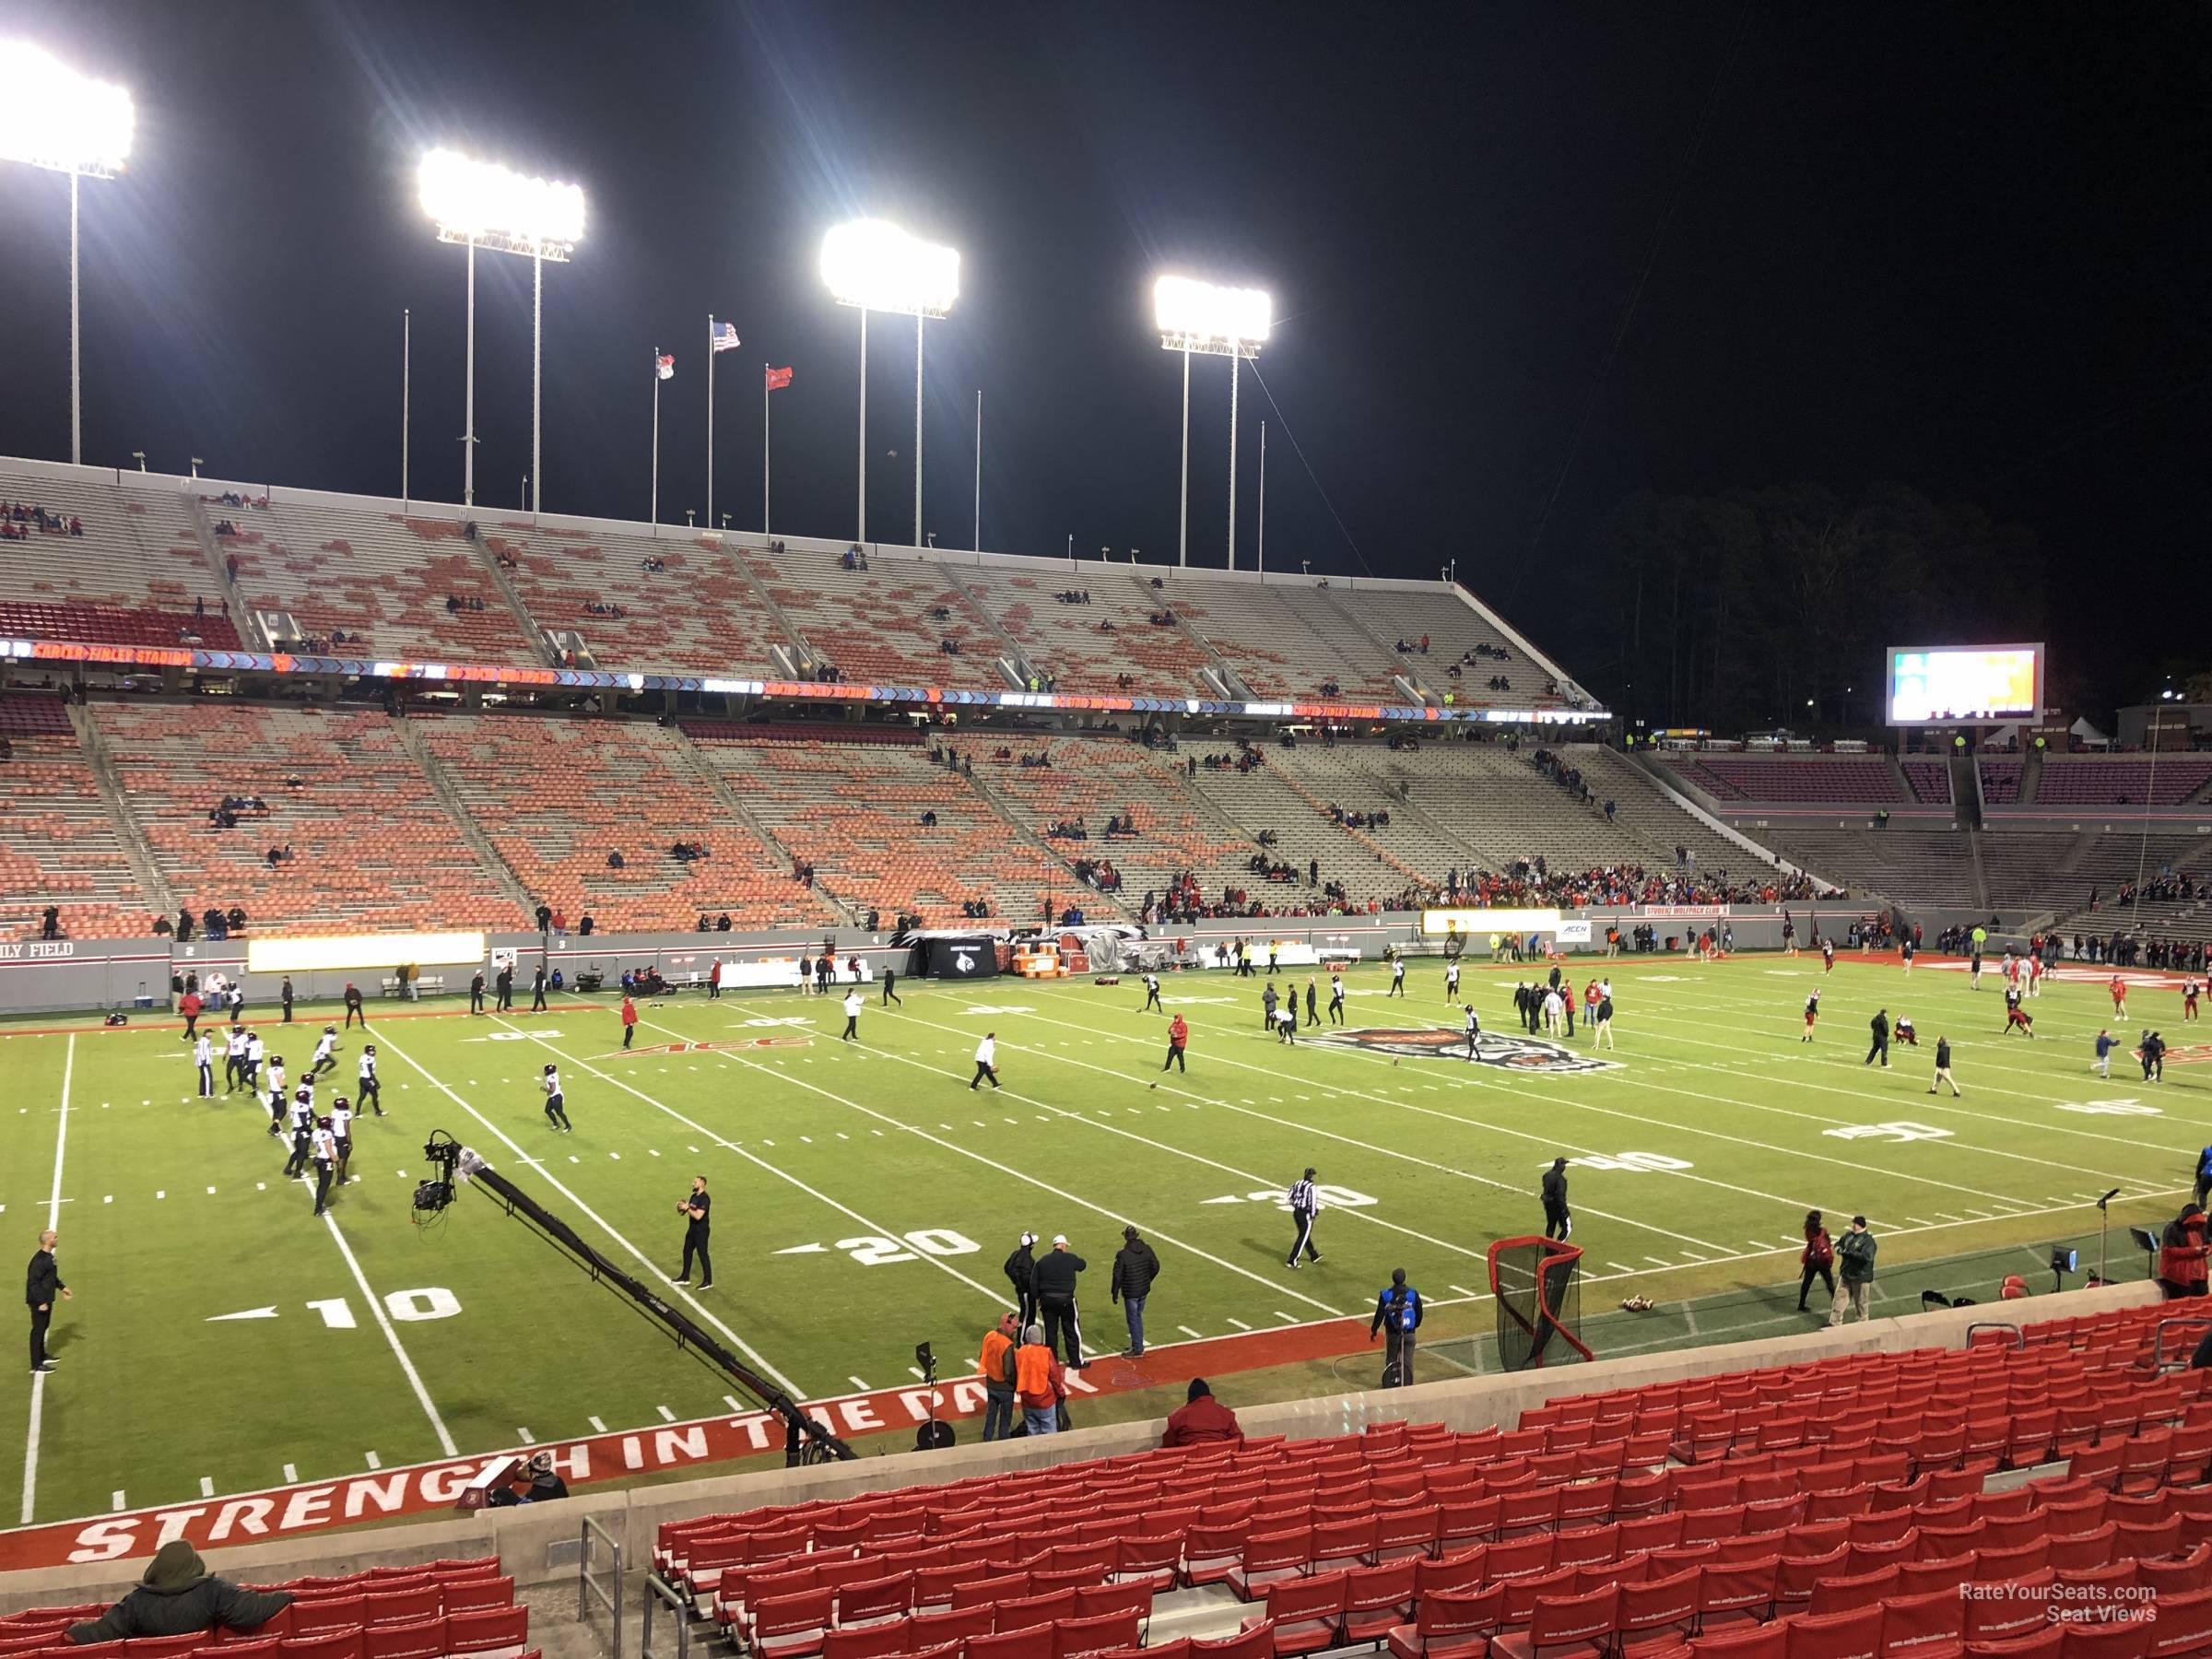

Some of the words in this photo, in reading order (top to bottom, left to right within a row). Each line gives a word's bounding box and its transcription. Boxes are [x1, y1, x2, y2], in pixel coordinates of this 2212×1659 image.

[135, 648, 193, 665] STADIUM
[29, 942, 74, 958] FIELD
[185, 947, 194, 957] 2
[559, 940, 566, 949] 3
[1248, 1184, 1379, 1211] 30
[834, 1229, 982, 1266] 20
[307, 1286, 462, 1329] 10
[621, 1426, 710, 1470] IN
[899, 1366, 1100, 1422] PAK
